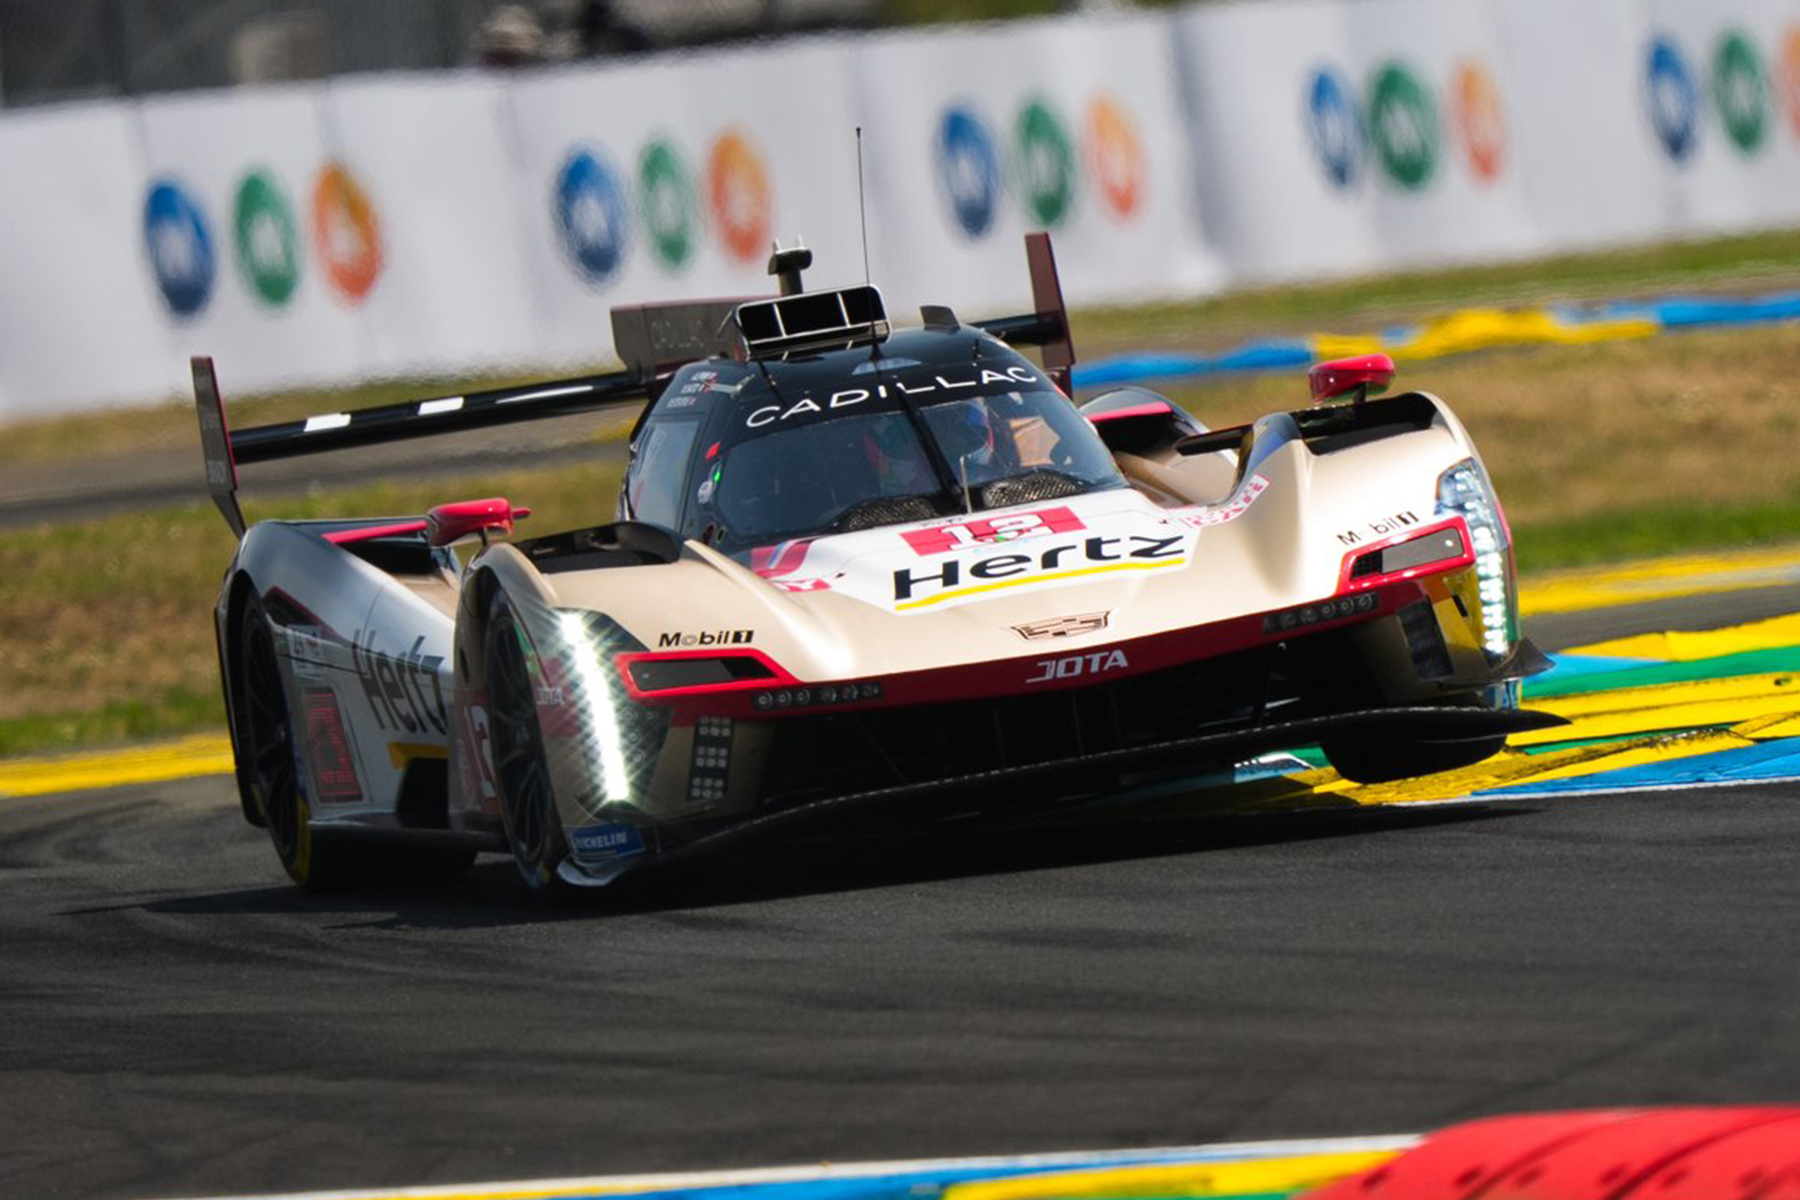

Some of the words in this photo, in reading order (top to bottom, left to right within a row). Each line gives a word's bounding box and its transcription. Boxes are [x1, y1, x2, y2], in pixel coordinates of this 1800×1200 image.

[746, 367, 1037, 428] CADILLAC
[1336, 516, 1401, 546] Mbil
[893, 535, 1184, 601] Hertz
[658, 630, 730, 648] Mobil
[352, 628, 449, 736] Hertz
[1025, 649, 1129, 683] JOTA
